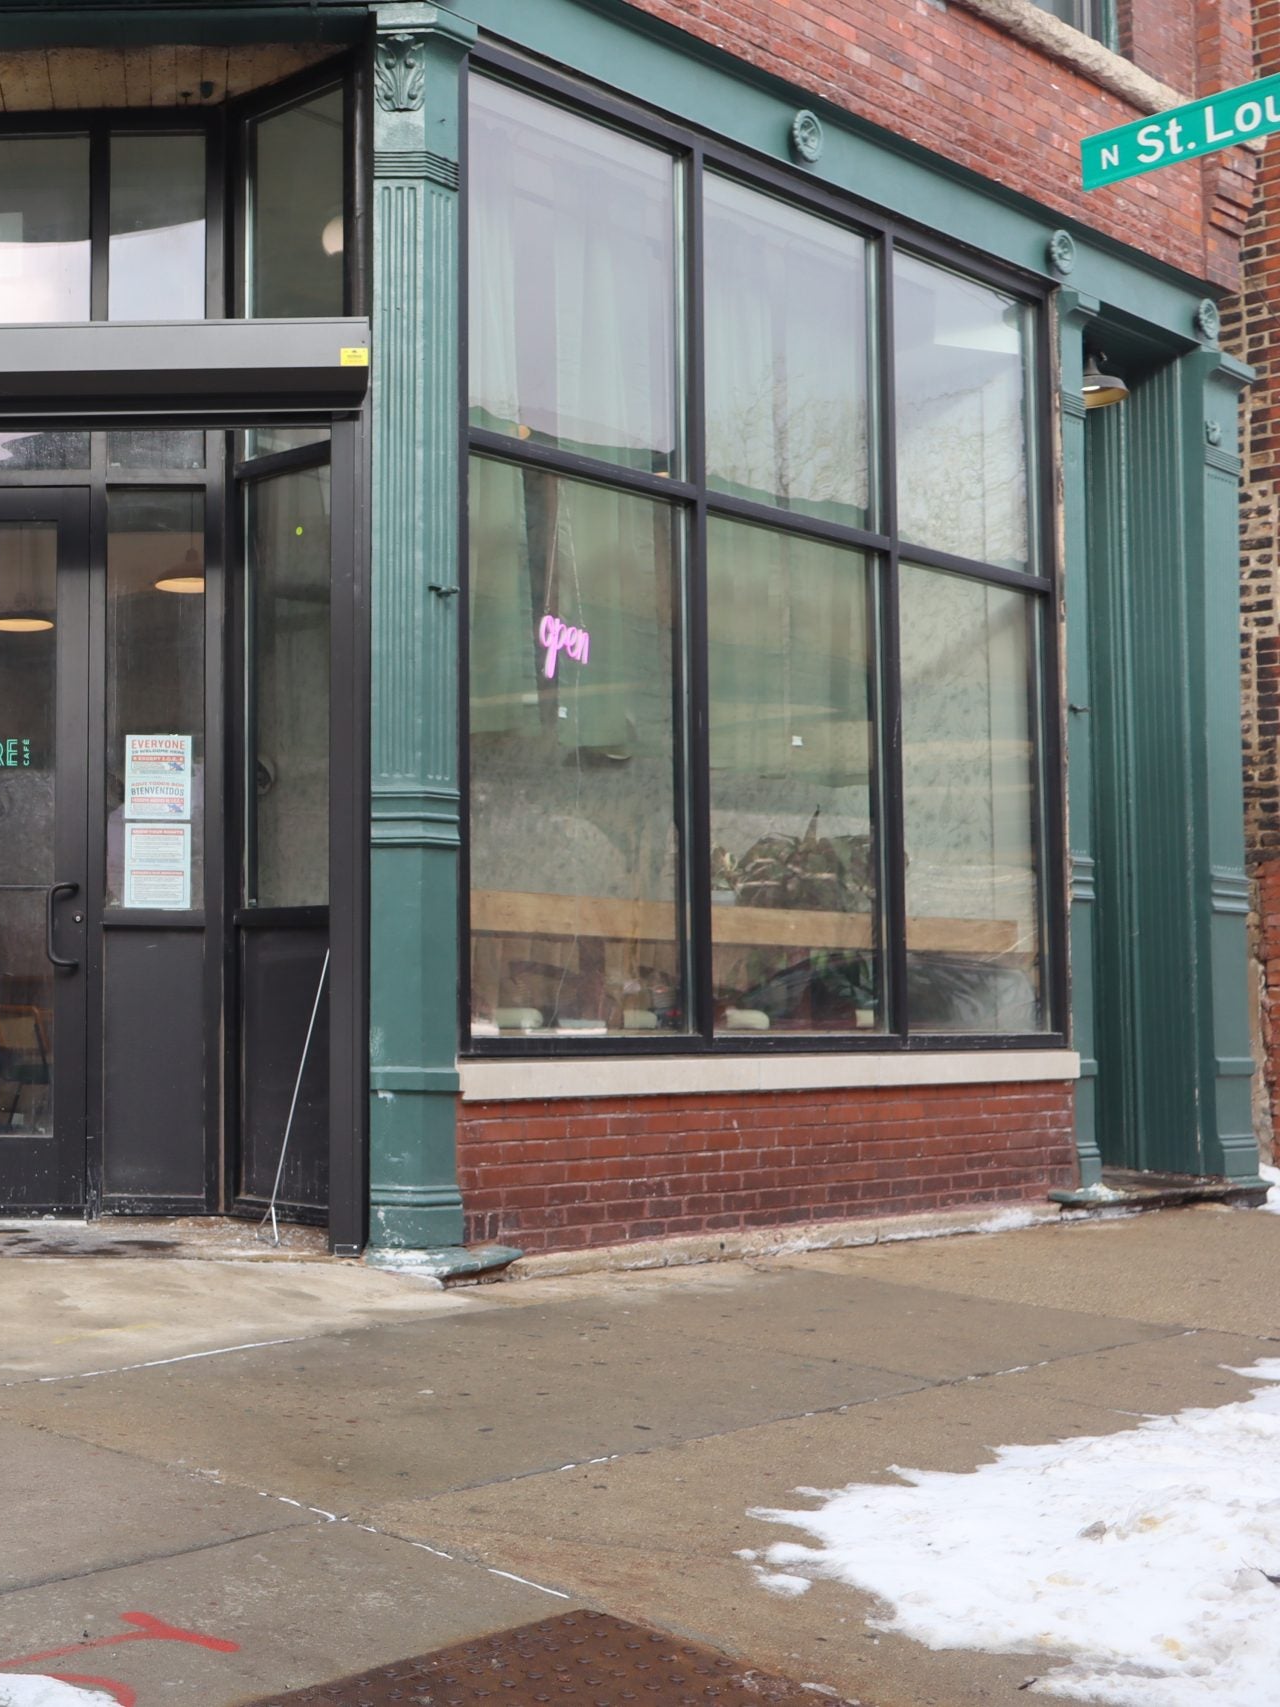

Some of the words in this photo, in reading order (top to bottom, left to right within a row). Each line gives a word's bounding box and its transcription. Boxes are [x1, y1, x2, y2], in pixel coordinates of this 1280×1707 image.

[1100, 144, 1120, 170] N
[1136, 118, 1197, 164] St.
[539, 614, 590, 679] open
[22, 738, 31, 767] CAFÉ
[131, 739, 185, 750] EVERYONE
[131, 786, 185, 796] BIENVENIDOS
